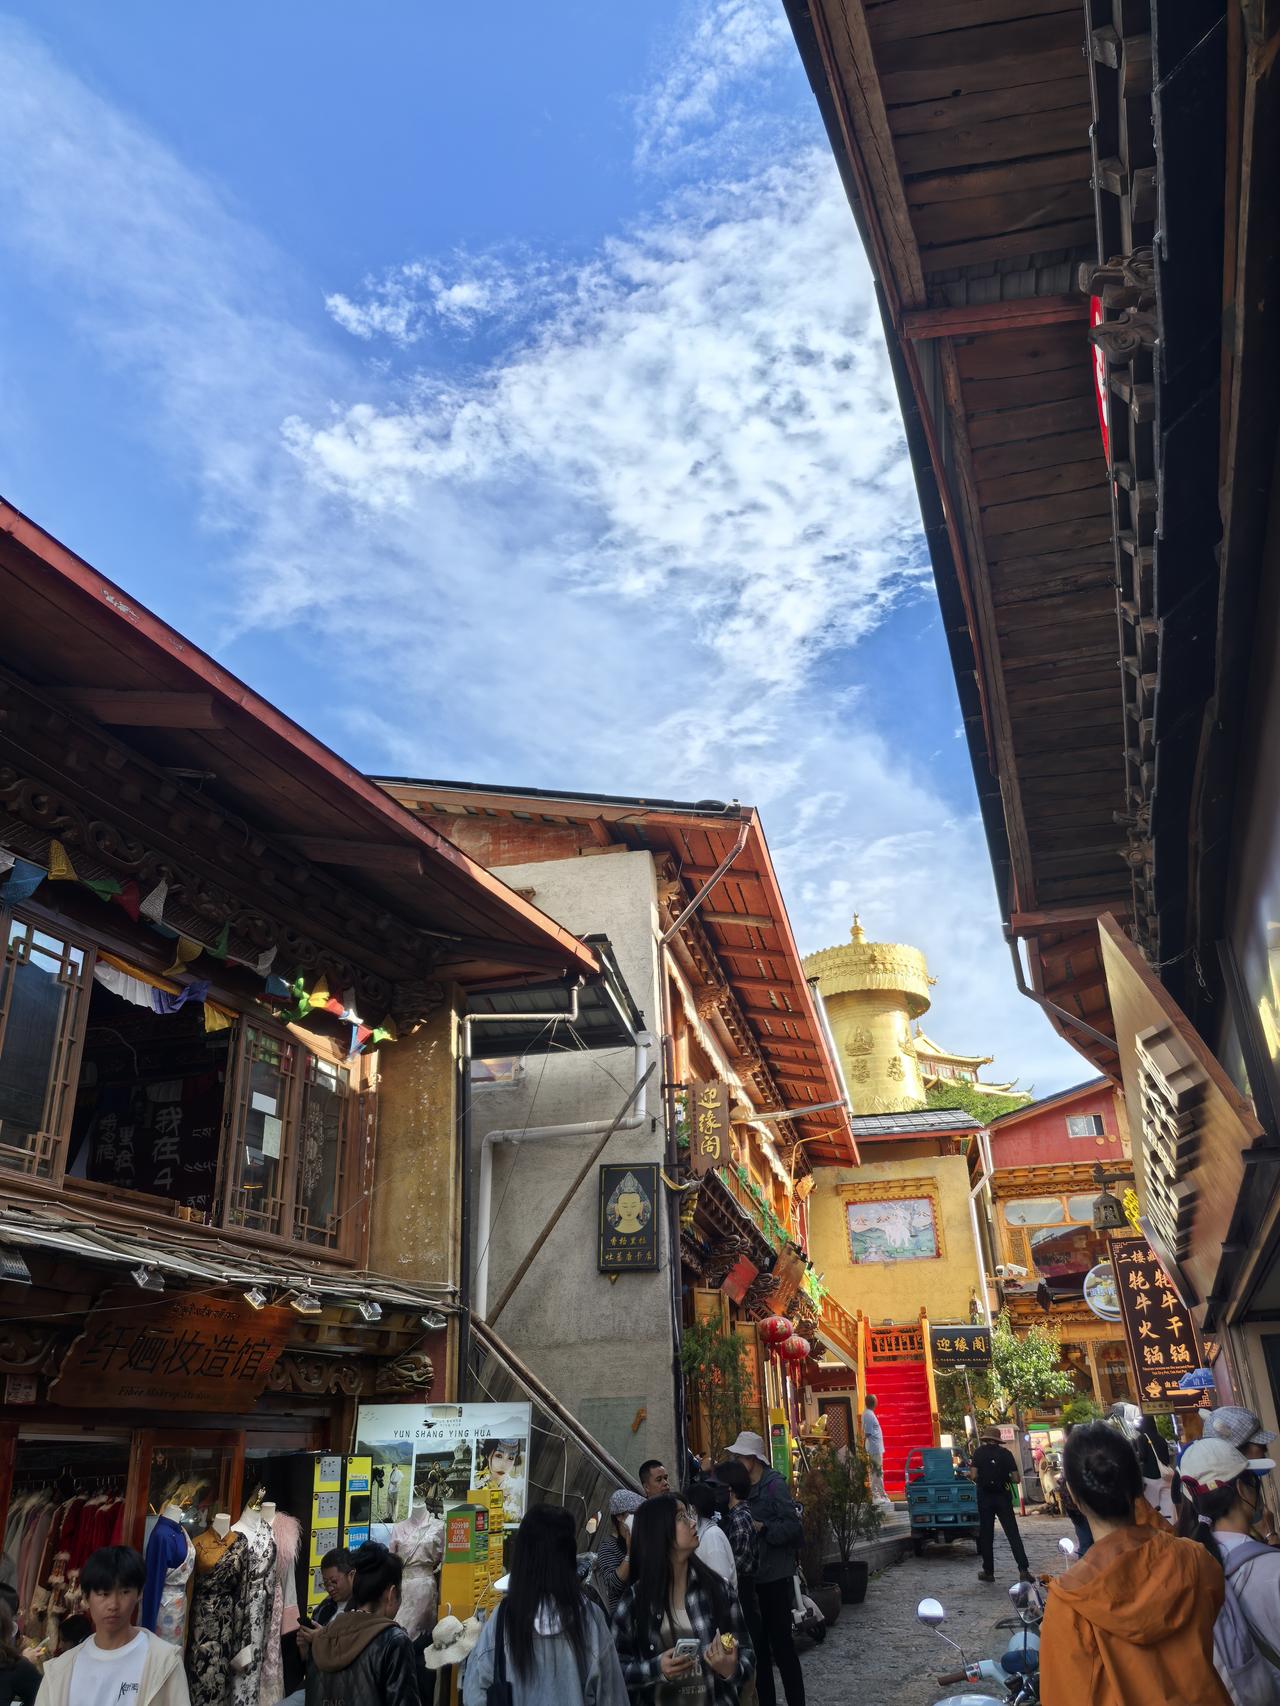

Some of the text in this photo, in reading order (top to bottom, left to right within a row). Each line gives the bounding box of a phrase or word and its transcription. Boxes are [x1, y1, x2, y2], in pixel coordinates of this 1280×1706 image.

[697, 1087, 722, 1160] 迎缘阁
[393, 1429, 492, 1438] YUN SHANG YING HUA
